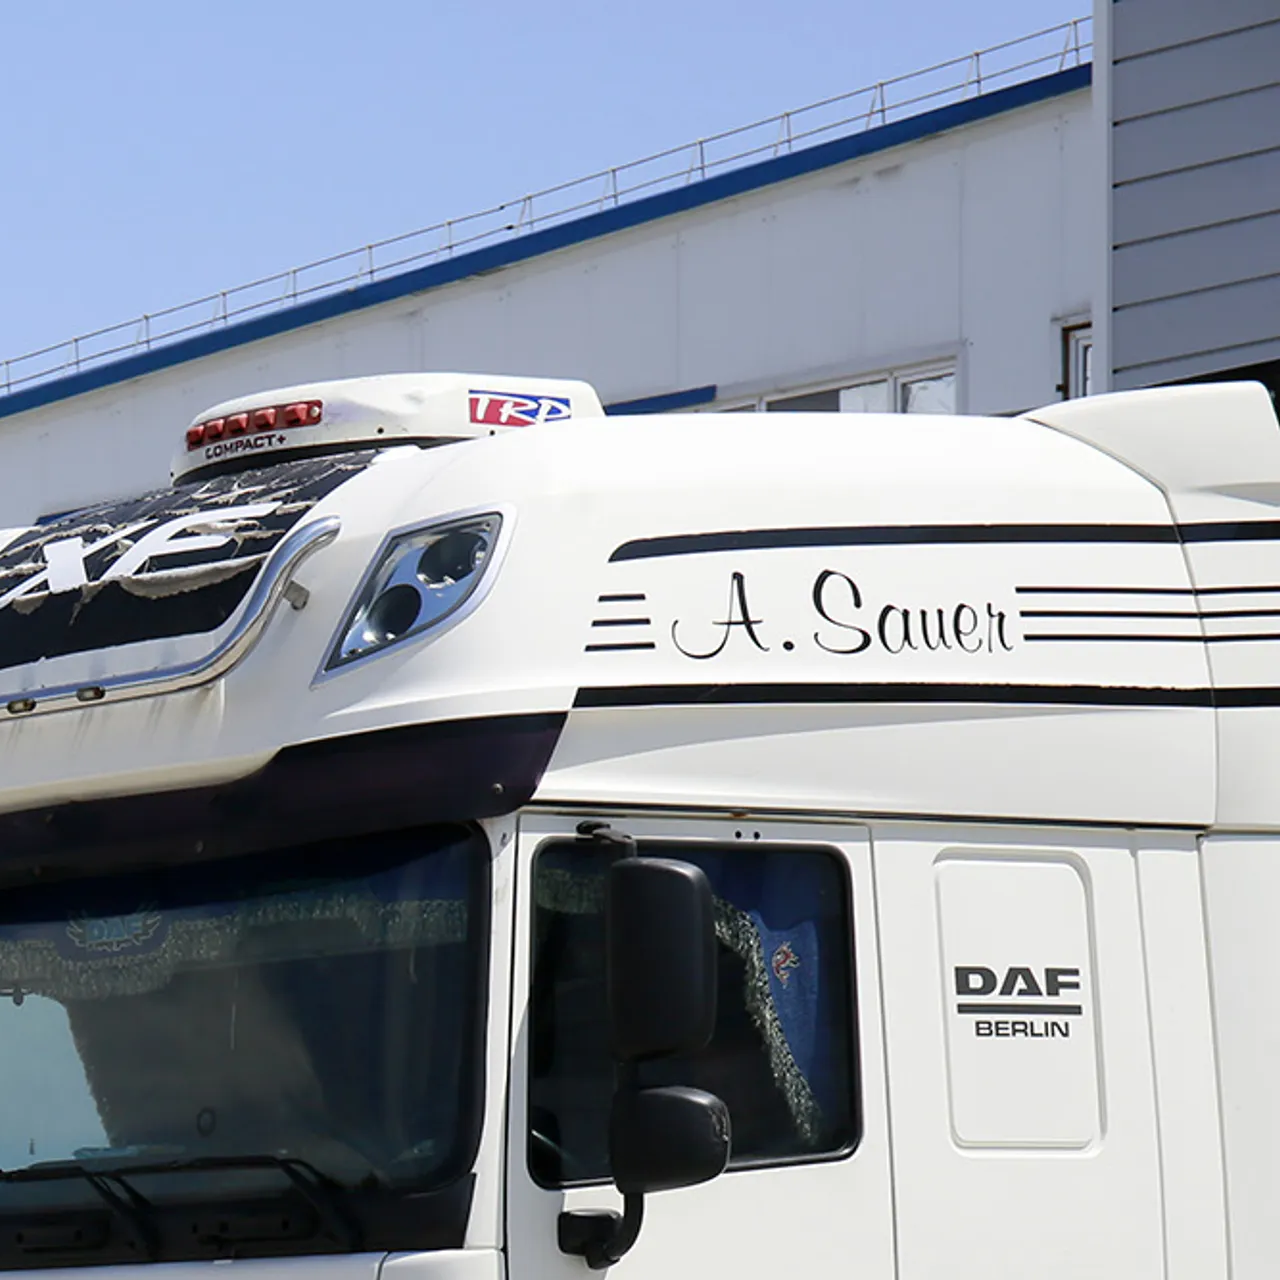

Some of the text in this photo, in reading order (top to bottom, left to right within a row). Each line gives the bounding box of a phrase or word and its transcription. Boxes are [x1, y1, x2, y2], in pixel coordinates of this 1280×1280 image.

[471, 395, 572, 425] TRP
[204, 433, 288, 460] COMPACT+
[671, 569, 1014, 660] A. Sauer
[85, 914, 143, 942] DAF
[954, 966, 1081, 997] DAF
[975, 1020, 1070, 1037] BERLIN
